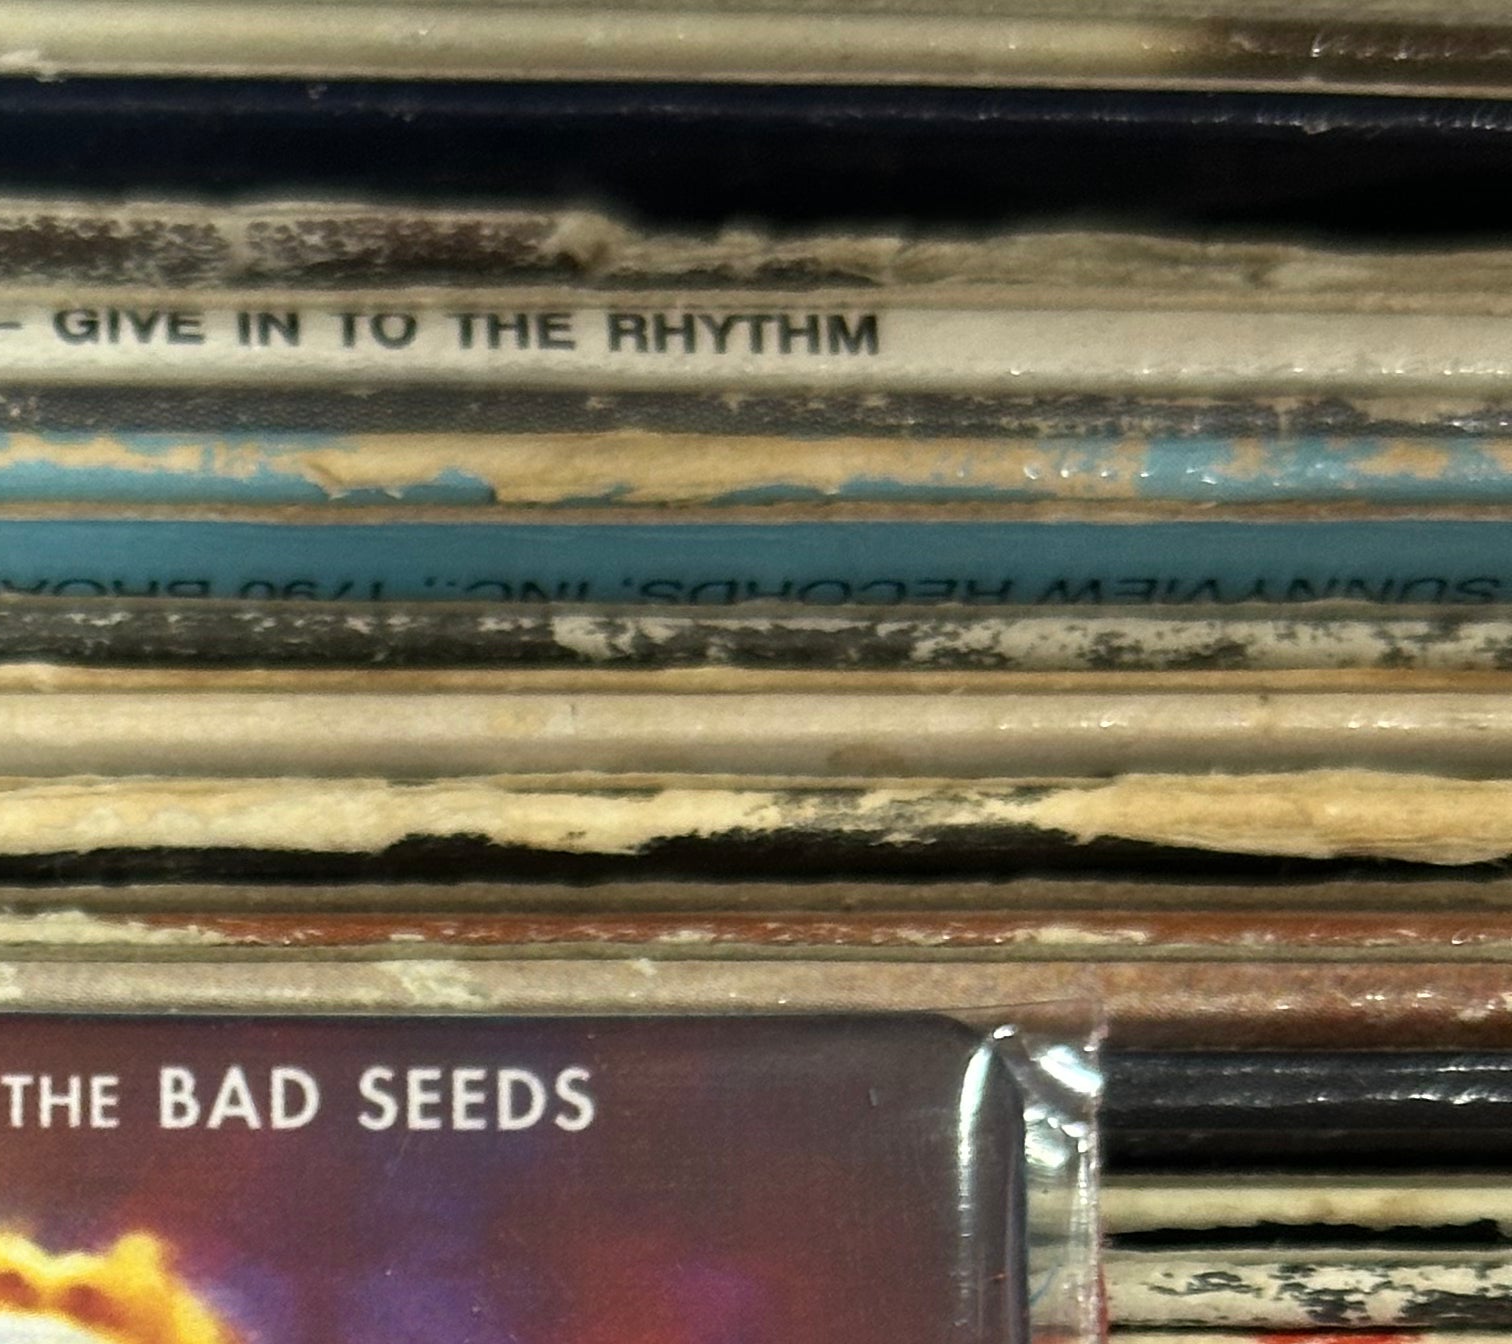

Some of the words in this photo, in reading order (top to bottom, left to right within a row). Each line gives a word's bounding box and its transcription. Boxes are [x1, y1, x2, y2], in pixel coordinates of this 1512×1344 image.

[52, 306, 206, 345] GIVE
[236, 310, 300, 348] IN
[332, 311, 418, 350] TO
[443, 311, 576, 352] THE
[607, 312, 880, 355] RHYTHM
[0, 1074, 120, 1129] THE
[159, 1066, 320, 1131] BAD
[357, 1066, 595, 1132] SEEDS
